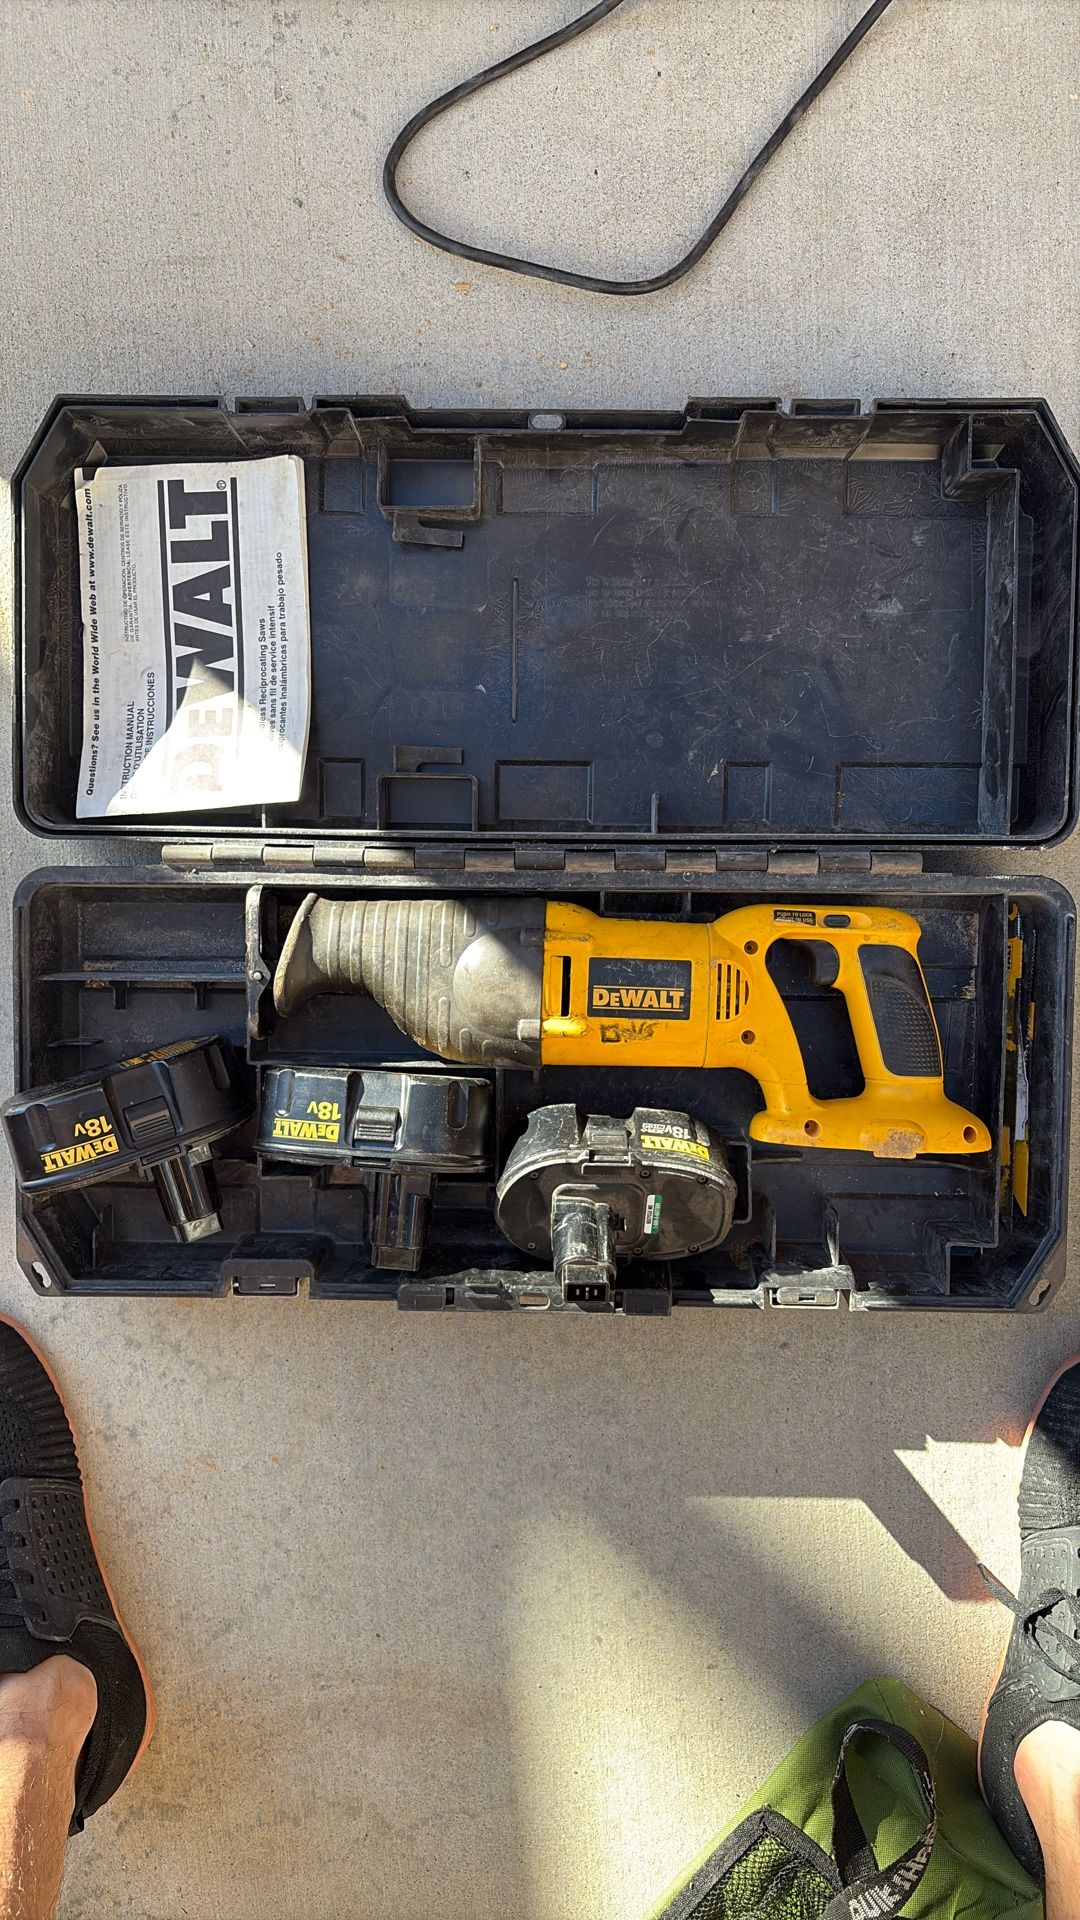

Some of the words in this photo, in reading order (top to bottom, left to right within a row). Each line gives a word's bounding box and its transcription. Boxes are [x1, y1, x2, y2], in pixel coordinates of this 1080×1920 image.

[85, 488, 95, 577] www.dewalt.com
[275, 552, 285, 585] pesado
[89, 580, 96, 591] at
[89, 594, 97, 616] Web
[277, 588, 286, 619] trabajo
[90, 618, 99, 643] Wide
[258, 618, 266, 642] Saws
[267, 605, 276, 639] intensif
[280, 622, 288, 641] para
[91, 646, 100, 675] World
[269, 641, 277, 673] service
[92, 678, 100, 694] the
[259, 644, 268, 705] Reciprocating
[269, 675, 277, 686] de
[92, 697, 100, 706] in
[269, 687, 277, 697] fil
[93, 709, 100, 721] us
[126, 701, 135, 740] MANUAL
[146, 672, 155, 746] INSTRUCCIONES
[92, 723, 100, 742] See
[86, 744, 99, 796] Questions?
[592, 988, 684, 1009] DEWALT
[306, 1100, 342, 1120] 18V
[74, 1115, 113, 1137] 18V
[273, 1120, 340, 1140] DEWALT
[43, 1135, 119, 1173] DEWALT
